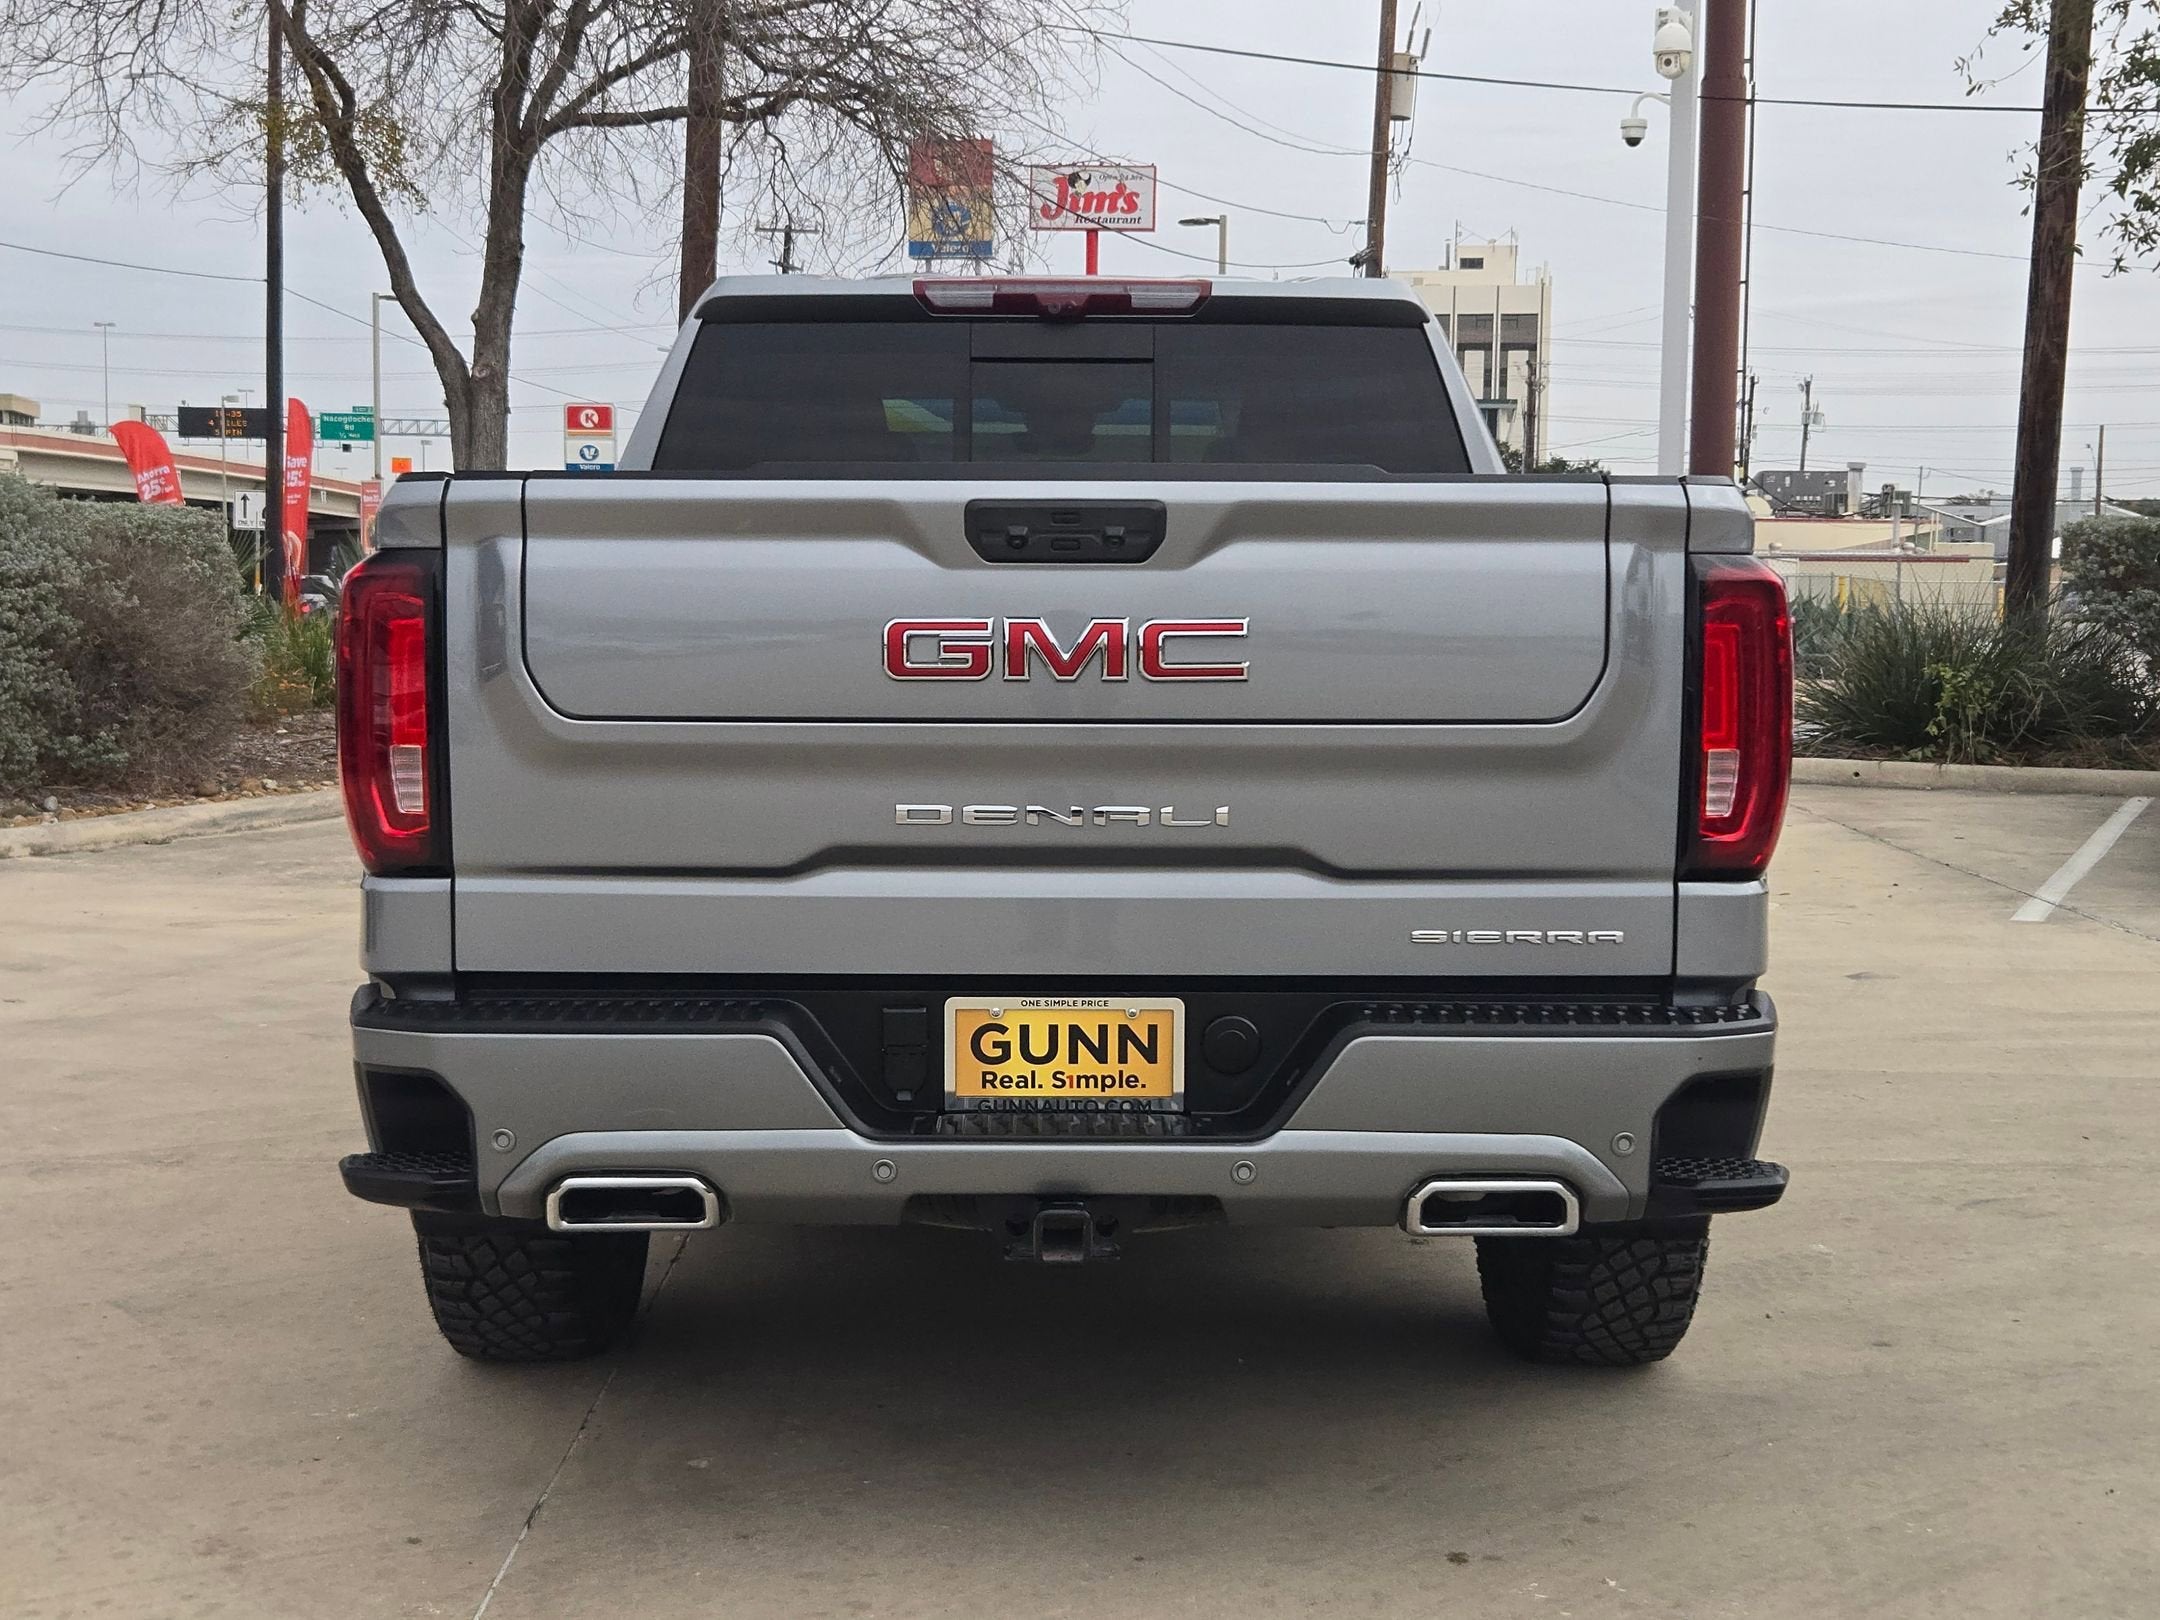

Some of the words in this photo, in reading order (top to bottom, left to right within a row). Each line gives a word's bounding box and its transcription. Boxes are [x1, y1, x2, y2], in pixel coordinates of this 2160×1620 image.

[1040, 176, 1140, 220] Jim's
[1074, 215, 1142, 225] Restaurant
[137, 464, 171, 485] Ahorra
[579, 463, 601, 471] Valero
[882, 615, 1251, 682] GMC
[894, 804, 1230, 827] DENALI
[1410, 929, 1625, 945] SIERRA
[1020, 999, 1042, 1008] ONE
[1043, 999, 1079, 1008] SIMPLE
[1080, 999, 1110, 1008] PRICE
[970, 1022, 1159, 1066] GUNN
[981, 1070, 1044, 1090] Real.
[977, 1099, 1152, 1114] GUNNAUTO.COM
